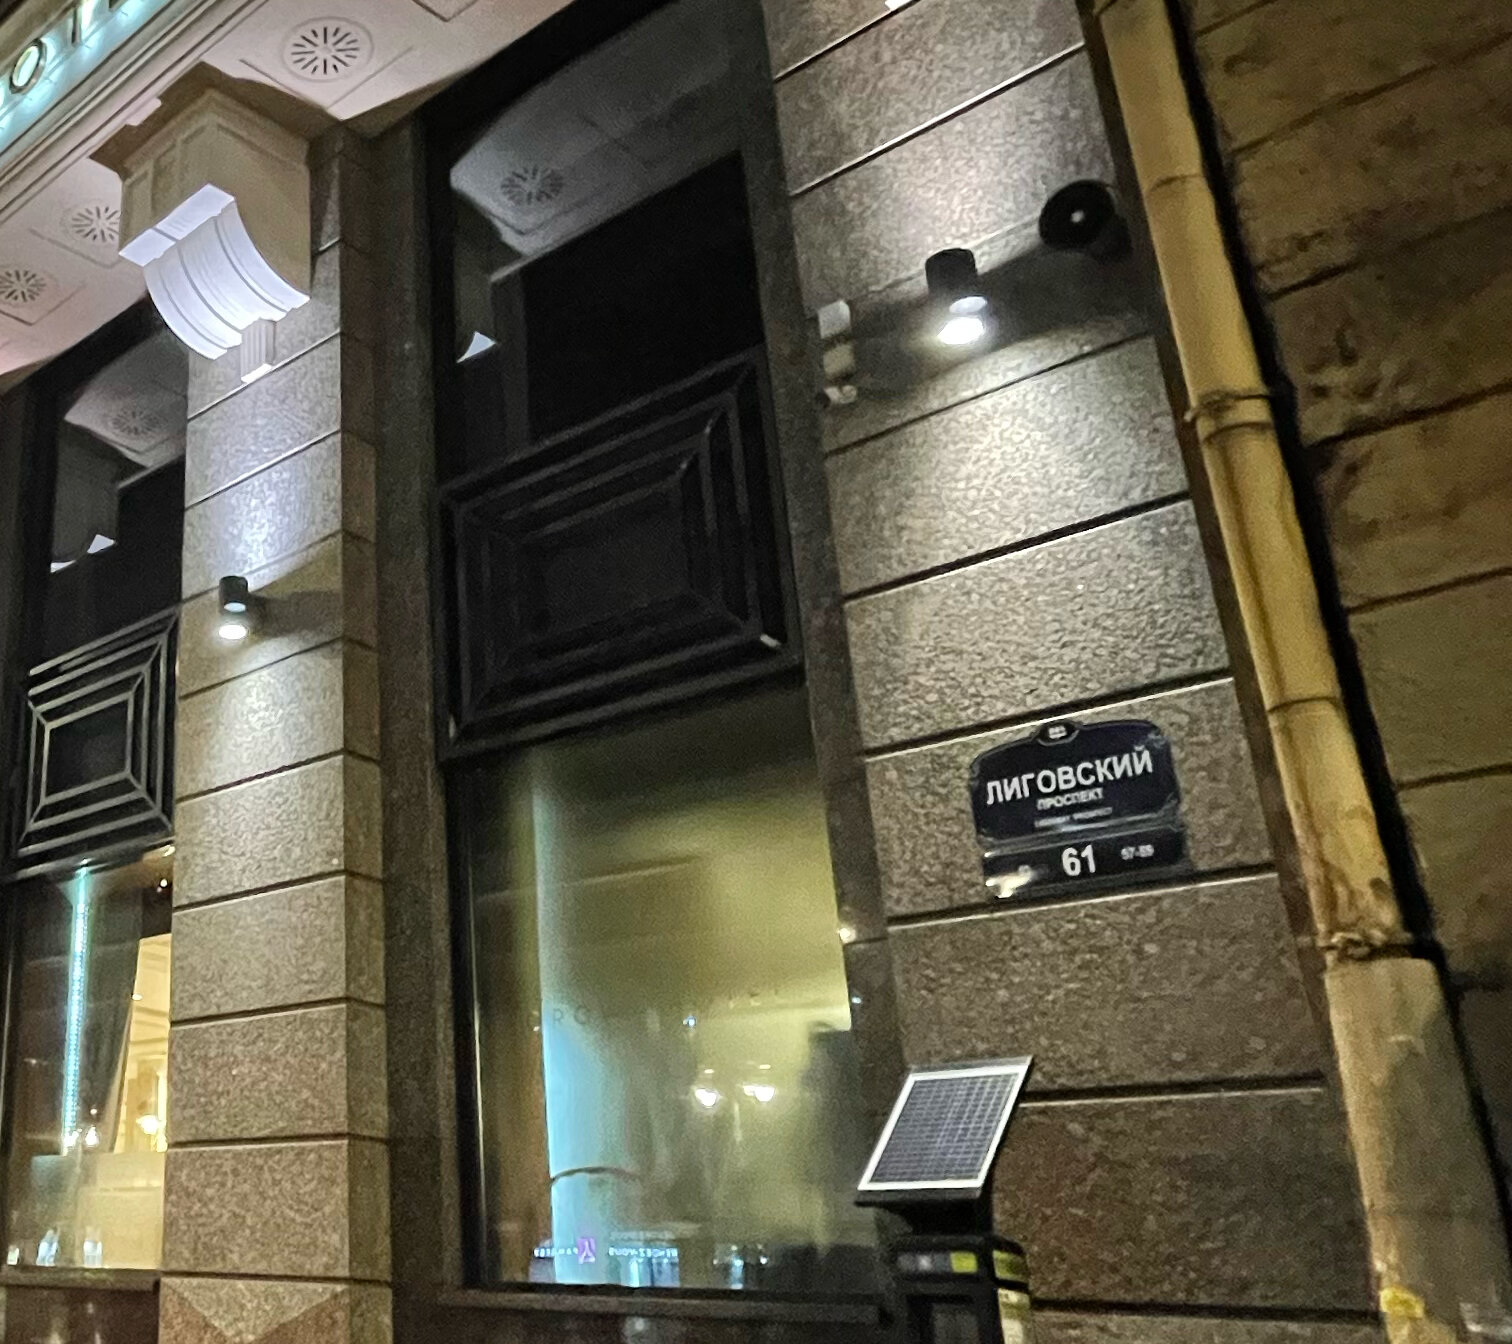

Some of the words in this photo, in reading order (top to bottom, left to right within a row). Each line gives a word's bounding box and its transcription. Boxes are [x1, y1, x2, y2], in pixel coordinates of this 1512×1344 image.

[986, 744, 1153, 806] ЛИГОВСКИЙ
[1037, 787, 1104, 811] ПРОСПЕКТ
[1061, 844, 1097, 877] 61
